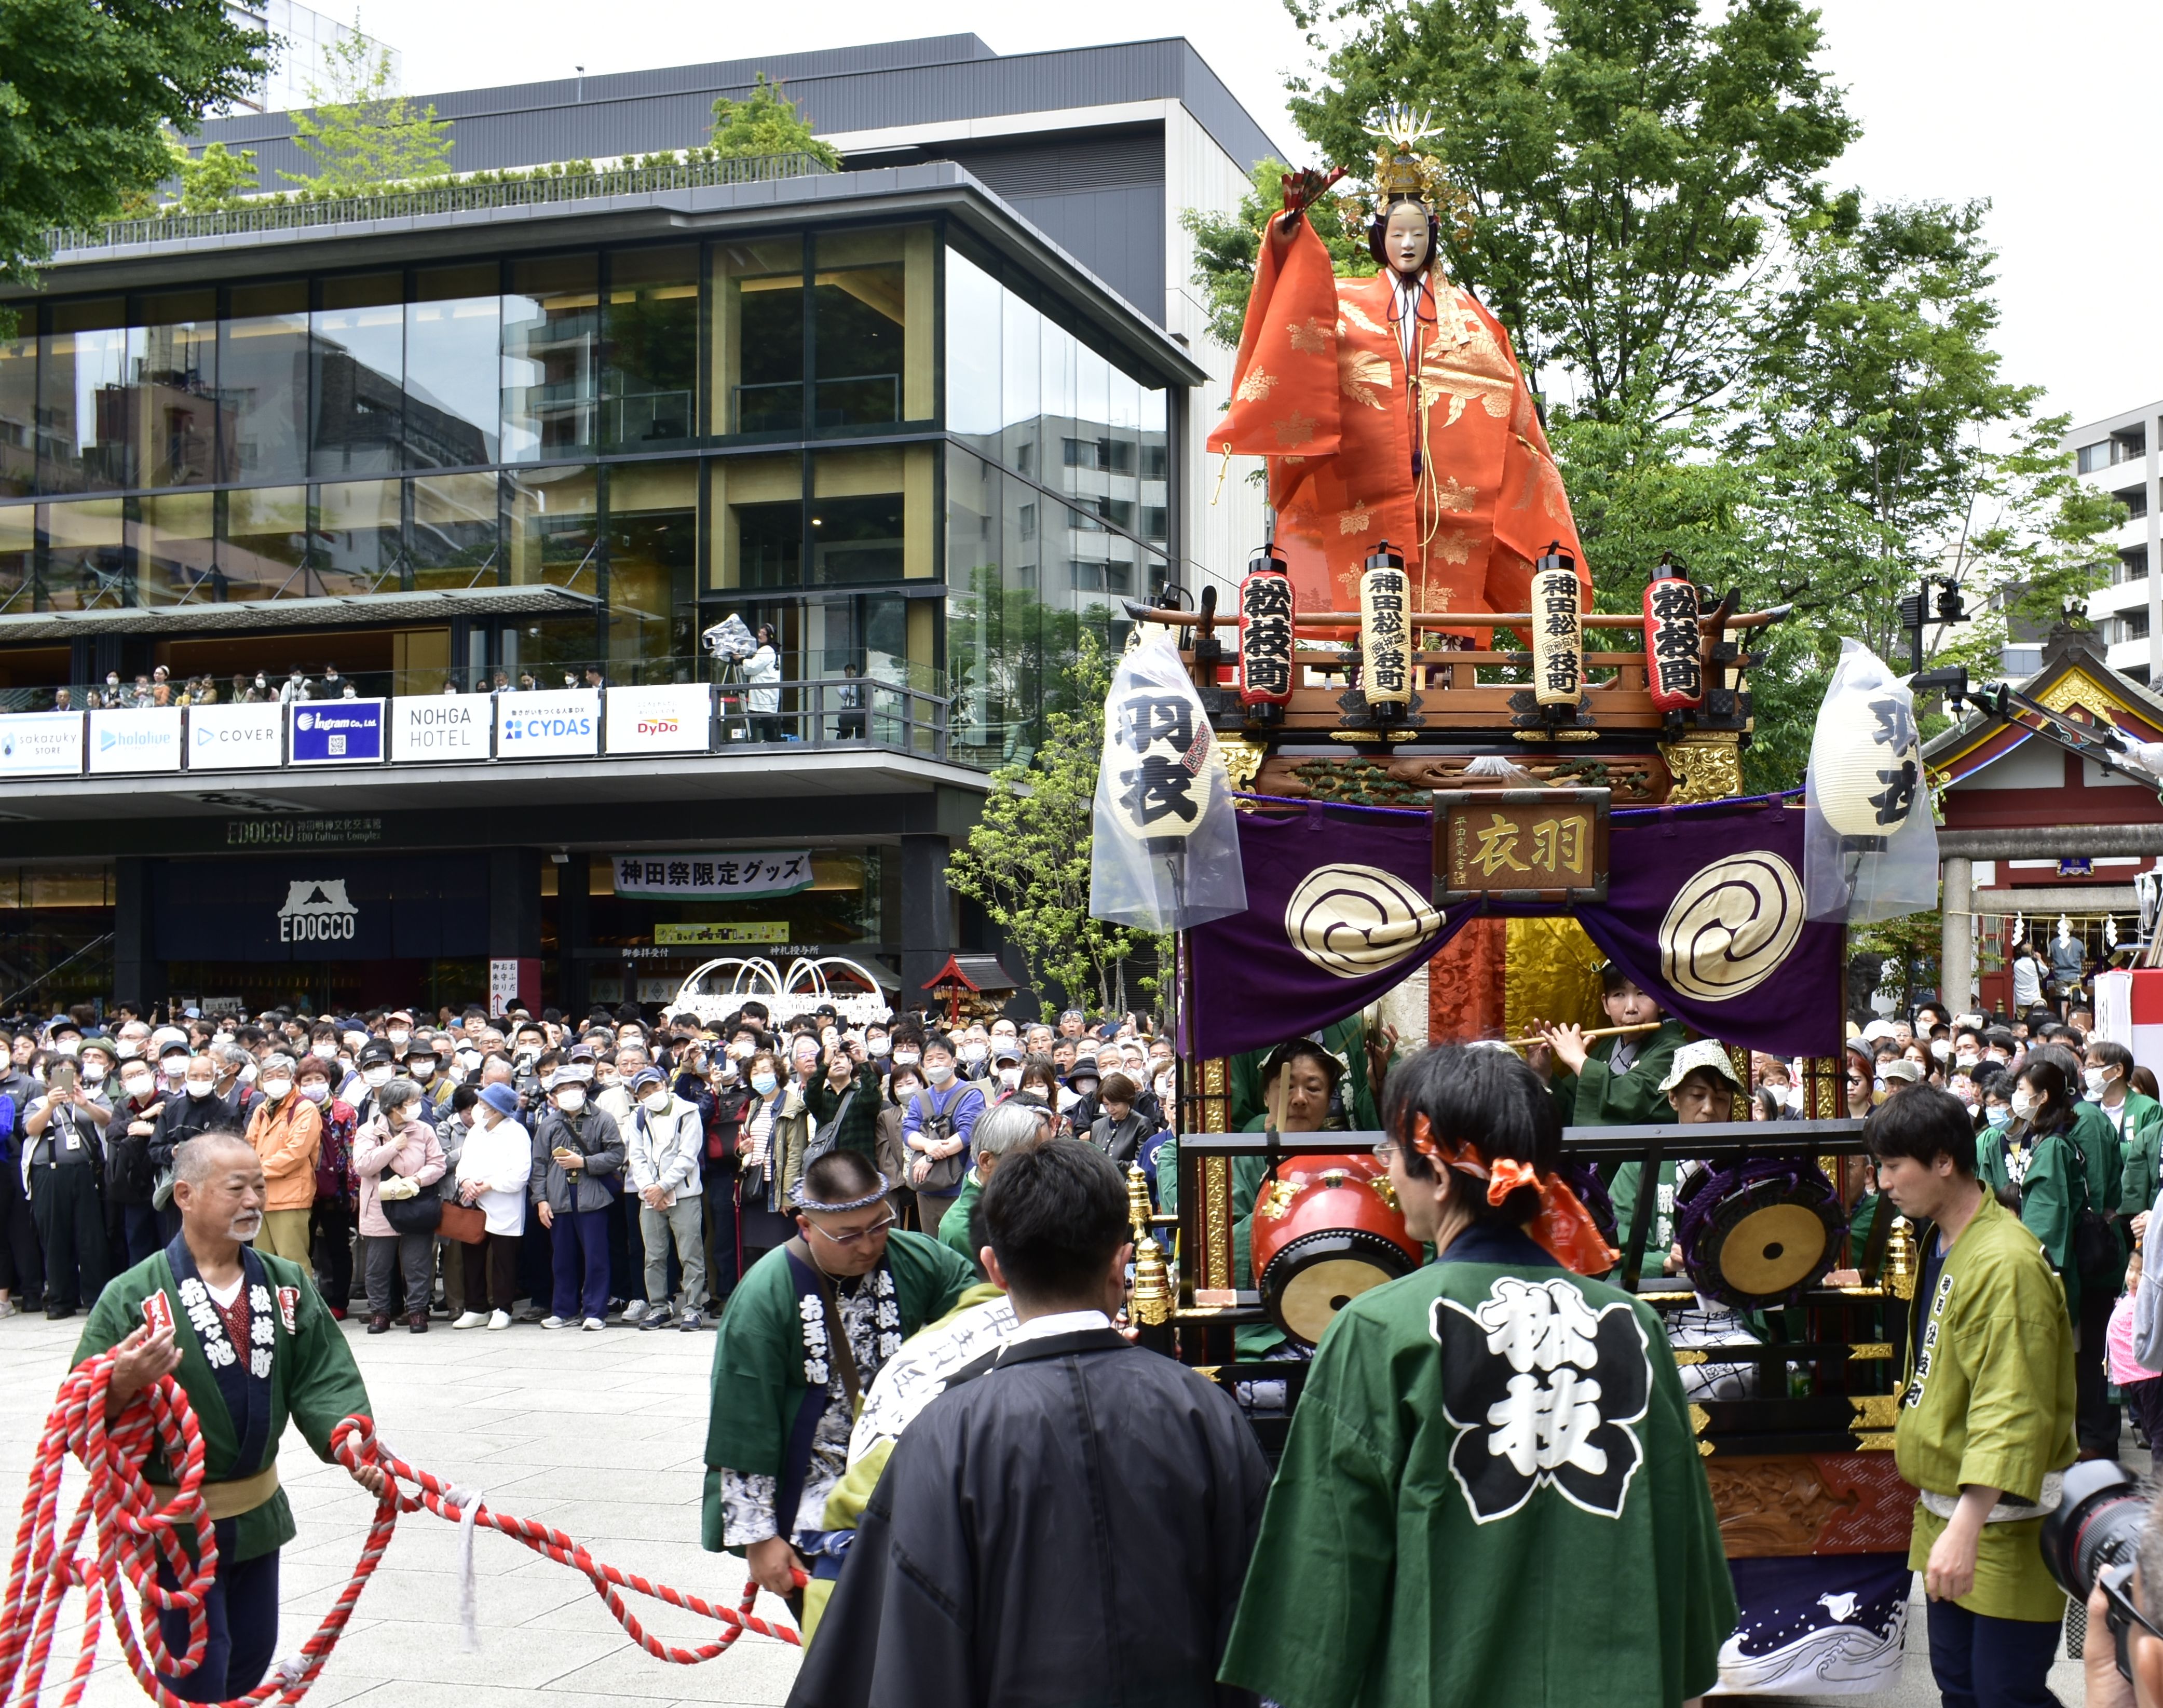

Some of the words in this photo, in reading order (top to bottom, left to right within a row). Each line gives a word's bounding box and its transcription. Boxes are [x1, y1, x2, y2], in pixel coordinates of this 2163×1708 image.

[1244, 577, 1291, 696] 松枝町
[1368, 571, 1406, 692] 神田松枝町
[1540, 573, 1579, 695] 神田松枝町
[411, 708, 471, 725] NOHGA
[220, 729, 274, 742] COVER
[528, 719, 590, 737] CYDAS
[638, 723, 678, 736] DyDo
[20, 733, 76, 746] sakazuky
[118, 732, 170, 745] hololive
[411, 729, 470, 748] HOTEL
[1114, 694, 1199, 828] 羽衣
[227, 821, 294, 844] EDOCCO
[315, 831, 345, 841] Culture
[347, 829, 382, 842] Complex
[1470, 814, 1587, 876] 羽衣
[621, 856, 805, 886] 神田祭限定グッズ
[280, 914, 355, 942] EDOCCO
[622, 948, 669, 958] 御参拝受付
[770, 945, 820, 956] 神札授与所
